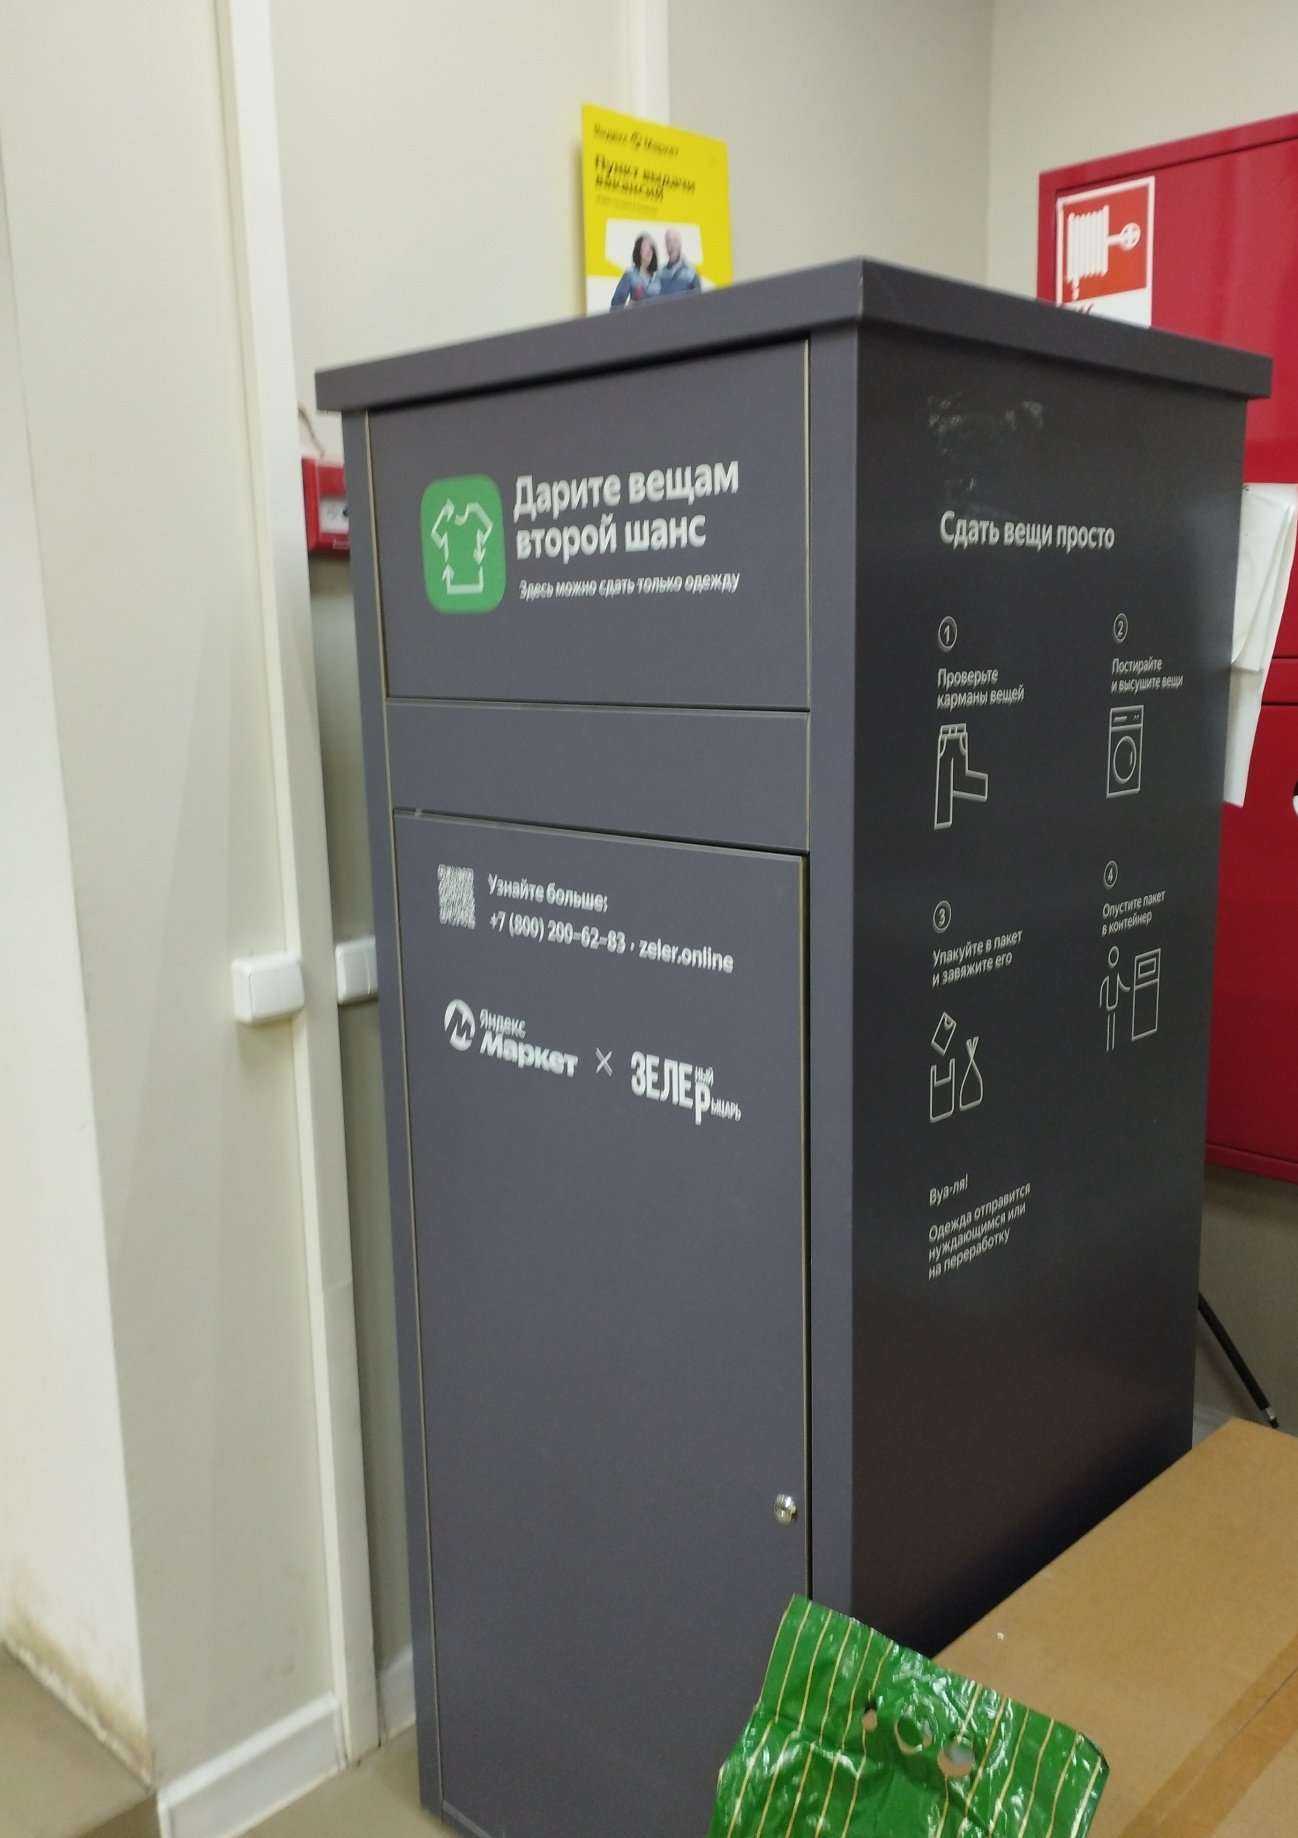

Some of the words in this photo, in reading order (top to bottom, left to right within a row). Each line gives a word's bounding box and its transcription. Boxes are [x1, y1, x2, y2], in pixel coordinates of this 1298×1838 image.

[513, 471, 621, 523] Дарите
[628, 460, 739, 505] вещам
[516, 513, 617, 564] второй
[625, 514, 707, 552] шанс
[940, 510, 999, 550] Сдать
[1004, 521, 1053, 552] вещи
[1056, 523, 1115, 553] просто
[519, 579, 554, 600] Здесь
[556, 579, 596, 599] можно
[599, 578, 635, 597] сдать
[637, 576, 681, 594] только
[685, 572, 740, 594] одежду
[938, 668, 999, 690] Проверьте
[1112, 656, 1163, 677] Постирайте
[937, 688, 988, 712] карманы
[990, 684, 1025, 705] вещей
[1111, 680, 1118, 692] и
[1119, 677, 1161, 696] высушите
[1162, 675, 1183, 690] вещи
[488, 873, 544, 902] Узнайте
[1102, 897, 1142, 919] Опустите
[1143, 889, 1166, 907] пакет
[1108, 910, 1153, 933] контейнер
[489, 912, 506, 932] +7
[509, 912, 545, 943] (800)
[547, 920, 627, 954] 200-62-83
[638, 938, 735, 974] zeler.online
[932, 941, 983, 969] Упакуйте
[985, 938, 992, 952] в
[994, 929, 1023, 949] пакет
[932, 971, 941, 988] и
[942, 957, 993, 985] завяжите
[995, 951, 1013, 969] его
[479, 1009, 527, 1038] Яндекс
[479, 1032, 579, 1078] Маркет
[929, 1173, 969, 1207] Вуа-ля!
[929, 1211, 972, 1242] Одежда
[974, 1183, 1031, 1220] отправится
[929, 1214, 1006, 1262] нуждающимся
[1008, 1204, 1026, 1222] или
[929, 1262, 942, 1280] на
[944, 1228, 1011, 1272] переработку
